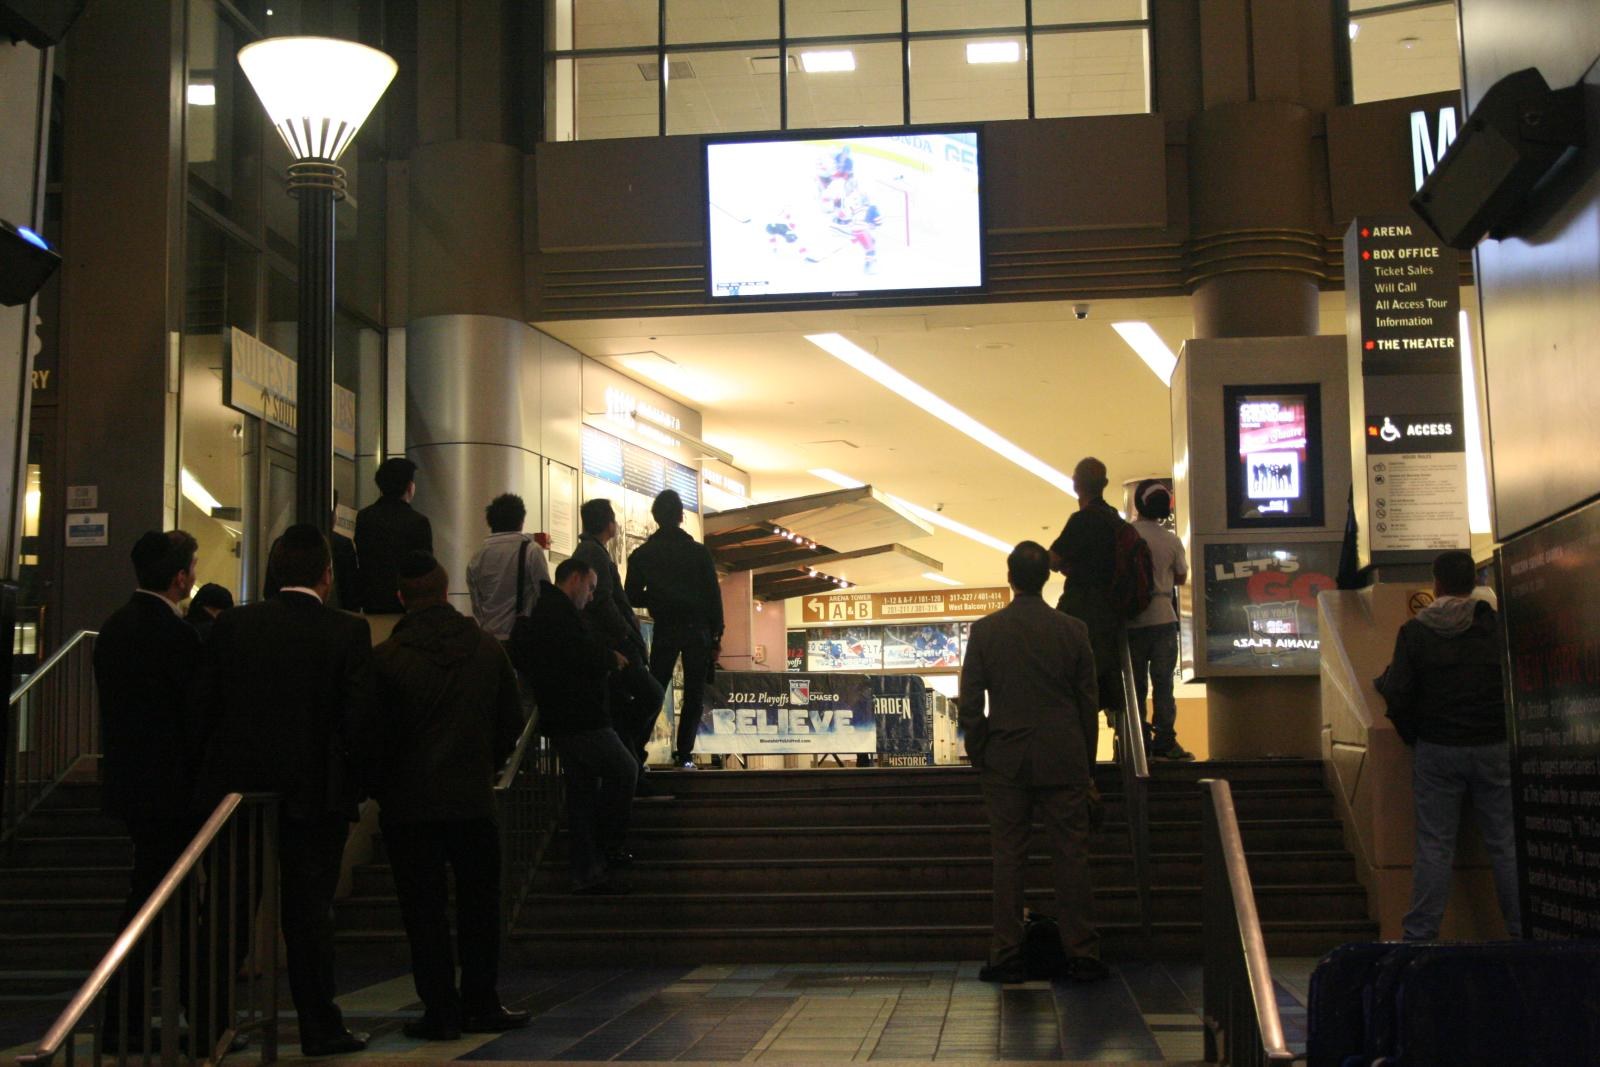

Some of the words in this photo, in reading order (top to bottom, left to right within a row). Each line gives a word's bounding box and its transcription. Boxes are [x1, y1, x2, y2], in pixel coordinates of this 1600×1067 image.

[1372, 226, 1412, 238] ARENA
[1372, 249, 1395, 260] BOX
[1398, 247, 1440, 259] OFFICE
[1375, 266, 1404, 277] Ticket
[1407, 265, 1434, 276] Sales
[1375, 283, 1395, 294] Will
[1397, 282, 1417, 293] Call
[1375, 300, 1390, 310] All
[1392, 299, 1425, 309] Access
[1426, 298, 1448, 309] Tour
[1376, 317, 1433, 328] Information
[1377, 339, 1401, 350] THE
[1402, 338, 1455, 349] THEATER
[31, 370, 50, 390] RY
[272, 394, 297, 429] SOUT
[1406, 423, 1453, 436] ACCESS
[833, 604, 844, 617] A
[847, 606, 854, 614] &
[859, 602, 868, 617] B
[964, 602, 987, 611] Balcony
[787, 658, 802, 667] yoffs
[728, 692, 756, 703] 2012
[757, 692, 790, 706] Playoffs
[874, 697, 912, 719] ARDEN
[712, 708, 855, 735] BELIEVE
[889, 756, 927, 766] HISTORIC
